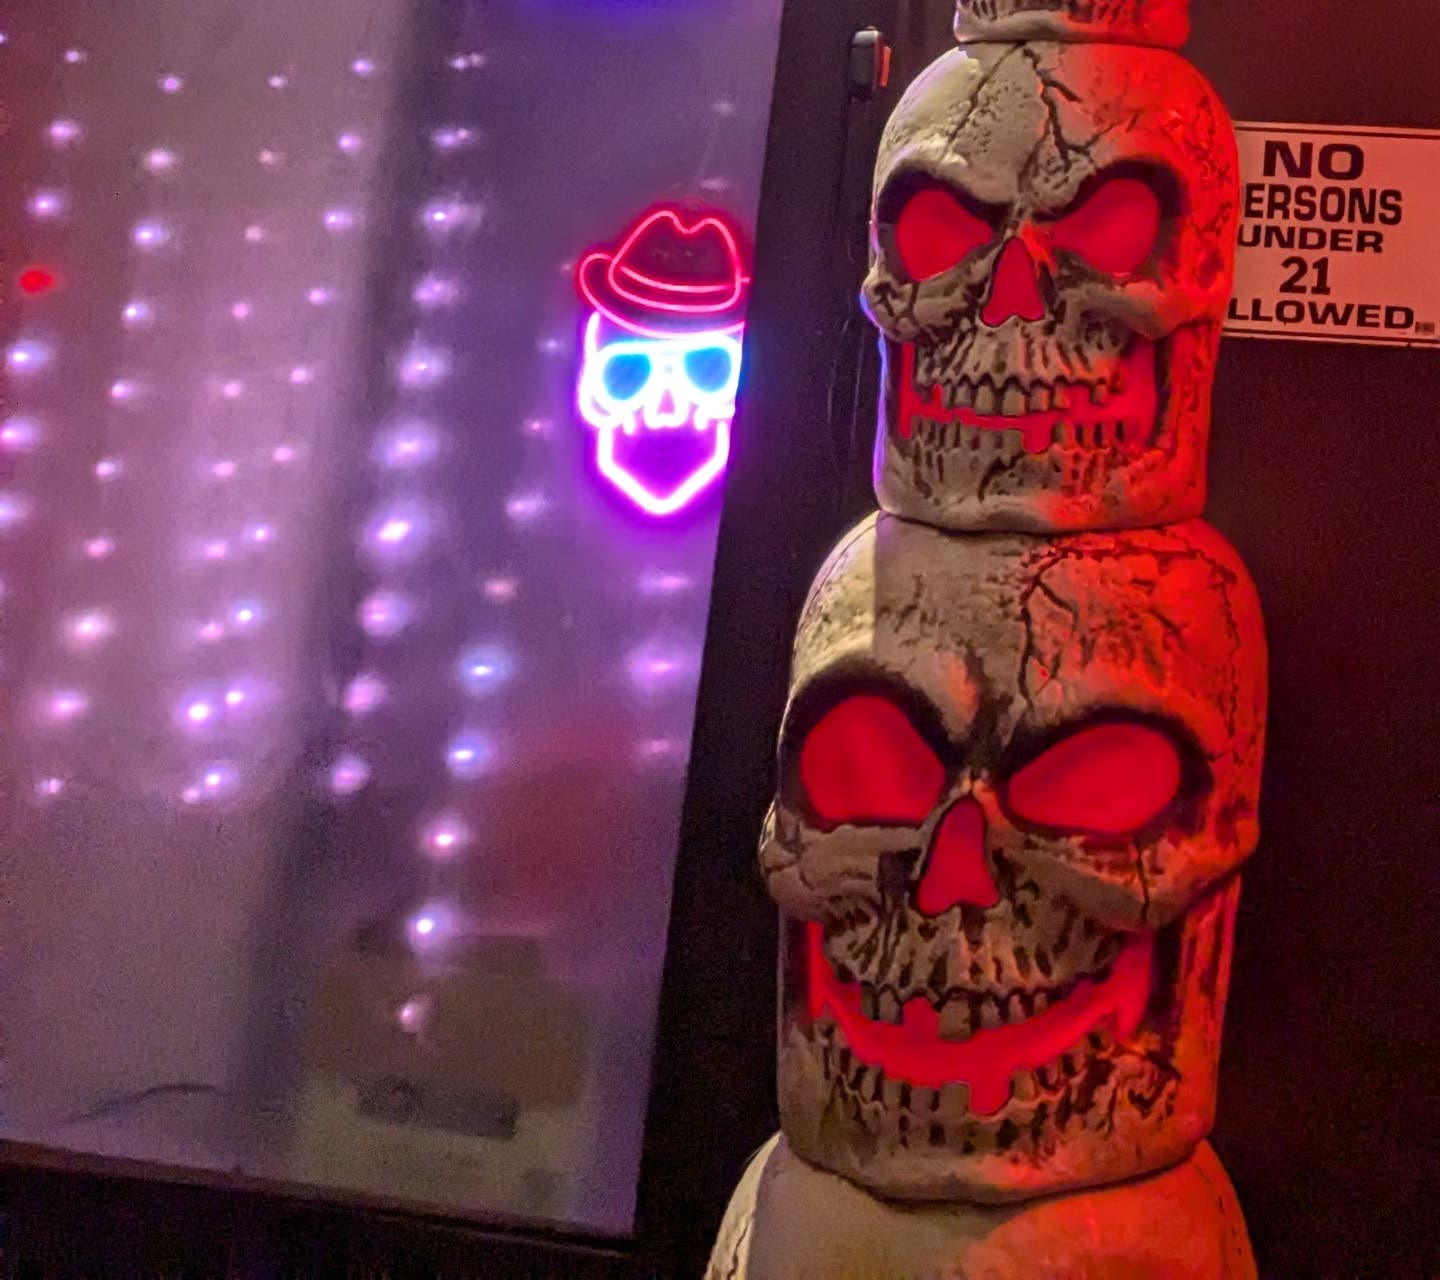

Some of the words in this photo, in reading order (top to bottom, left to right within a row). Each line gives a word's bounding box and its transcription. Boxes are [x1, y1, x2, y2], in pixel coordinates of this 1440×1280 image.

[1263, 140, 1364, 180] NO
[1244, 183, 1403, 225] ERSONS
[1237, 224, 1384, 253] UNDER
[1279, 256, 1331, 295] 21
[1227, 298, 1414, 329] LLOWED
